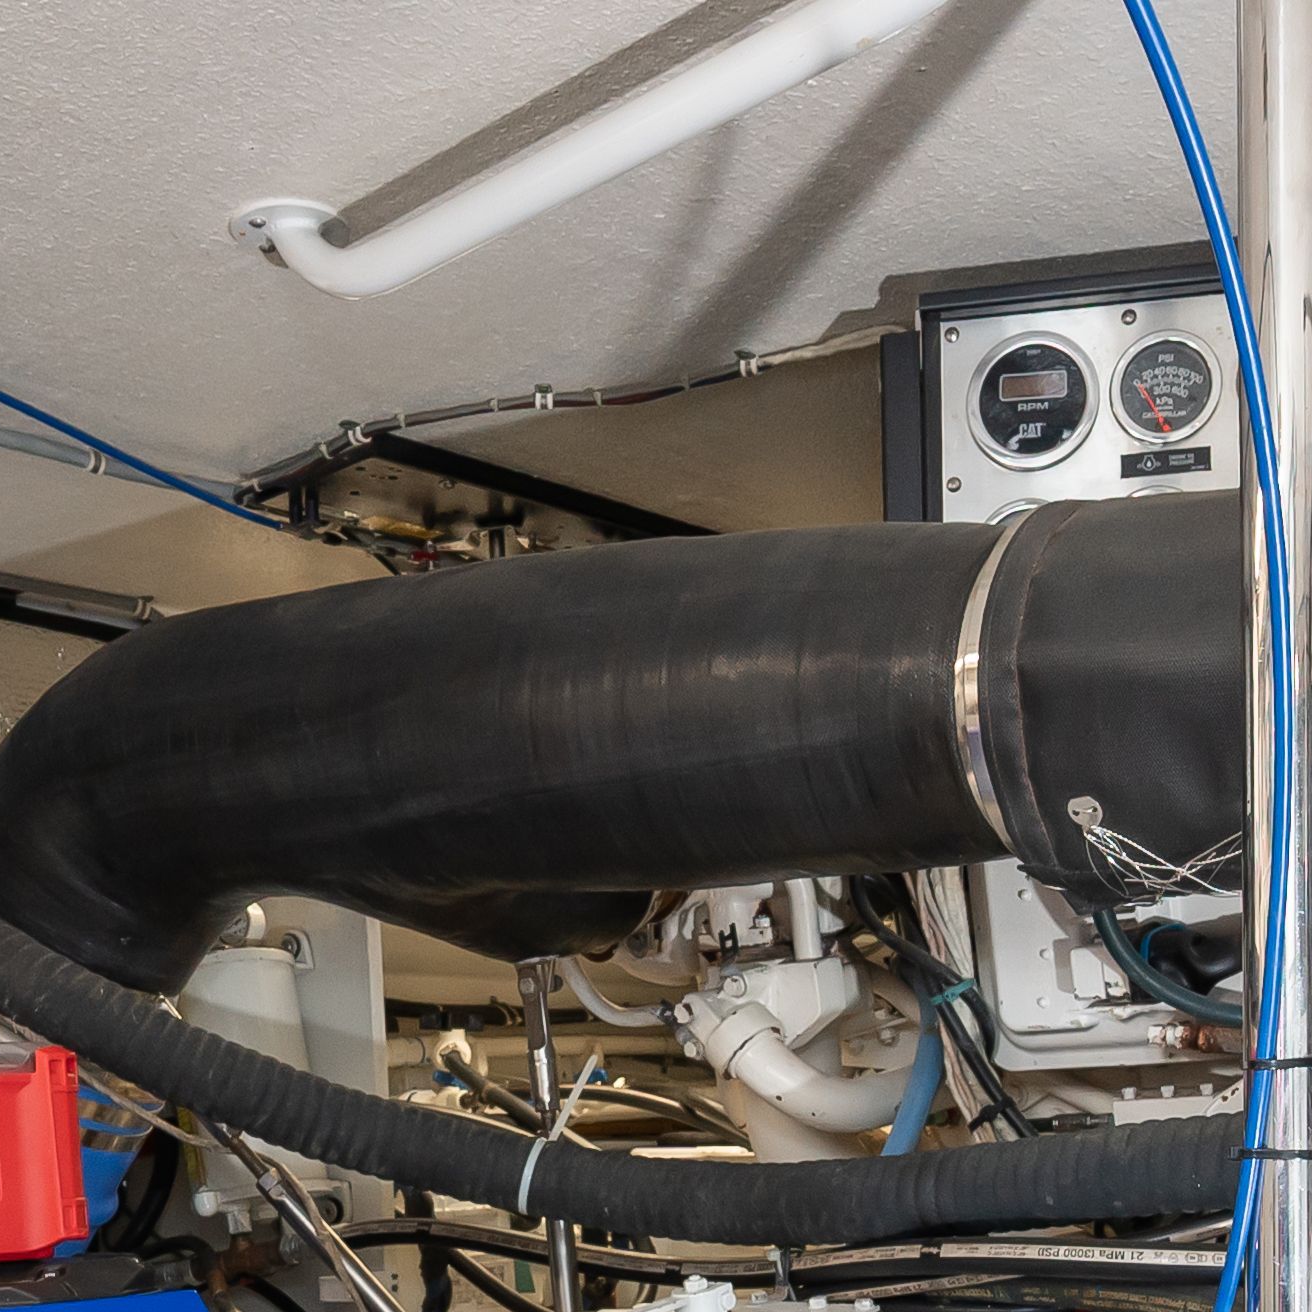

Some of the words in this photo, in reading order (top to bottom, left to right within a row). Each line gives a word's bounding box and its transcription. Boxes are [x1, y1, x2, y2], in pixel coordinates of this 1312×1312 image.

[1158, 353, 1174, 363] PSI
[1142, 369, 1153, 380] 20
[1154, 366, 1165, 376] 40
[1166, 365, 1178, 375] 60
[1178, 367, 1190, 377] 80
[1156, 396, 1173, 405] kPa
[1018, 402, 1048, 412] RPM
[1019, 423, 1043, 438] CAT
[1037, 1247, 1060, 1257] PSI)
[1063, 1247, 1095, 1259] (3000
[1099, 1249, 1125, 1260] MPa
[1131, 1250, 1144, 1261] 21
